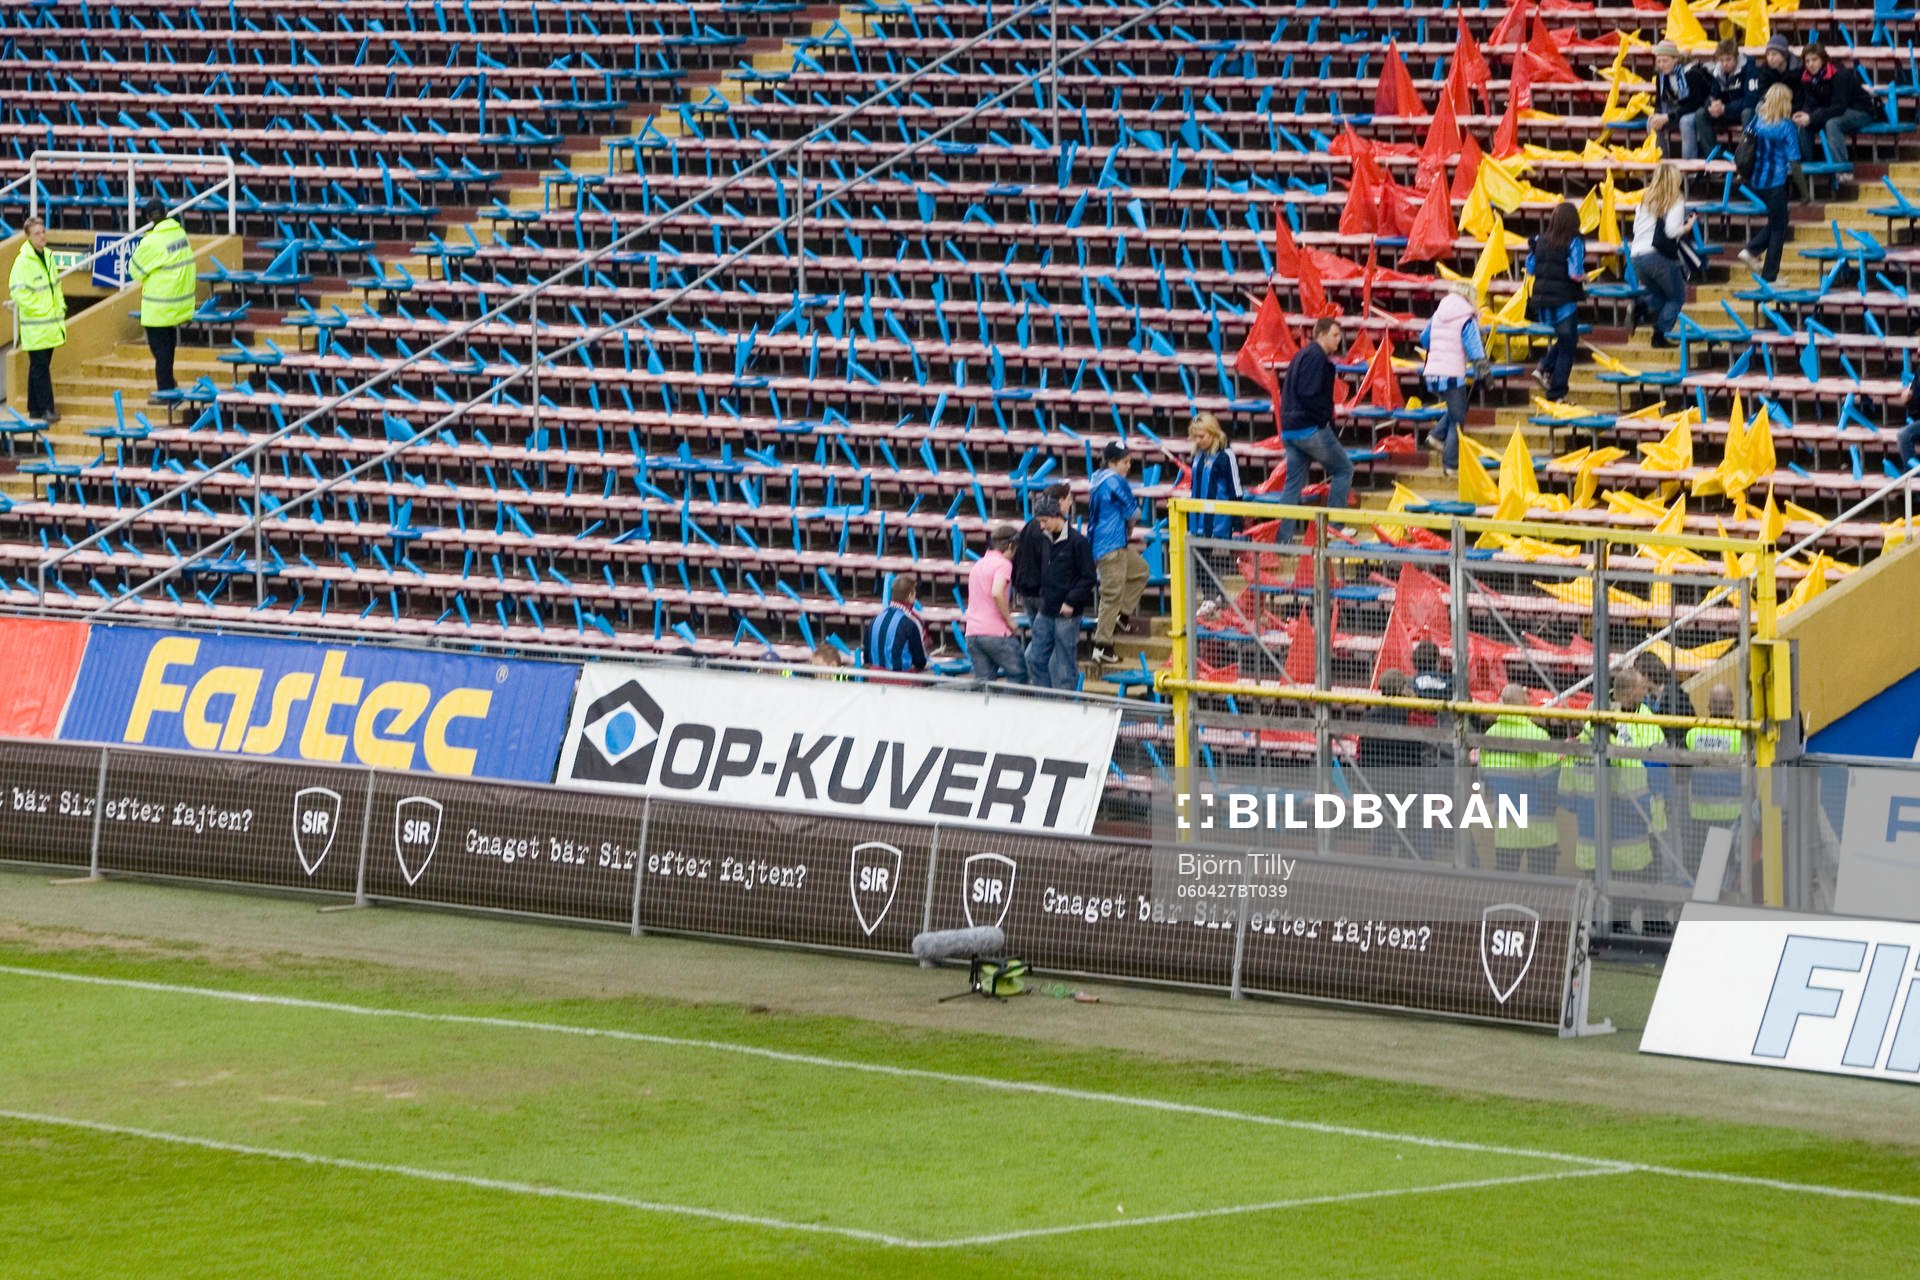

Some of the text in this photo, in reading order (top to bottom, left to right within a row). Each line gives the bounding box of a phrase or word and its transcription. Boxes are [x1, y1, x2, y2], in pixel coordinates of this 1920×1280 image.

[123, 637, 493, 776] Fastec
[659, 723, 1089, 828] OP-KUVERT
[13, 787, 50, 812] bär
[59, 790, 96, 816] Sir
[105, 797, 164, 823] efter
[171, 802, 253, 833] fajten?
[301, 810, 330, 835] SIR
[403, 819, 431, 845] SIR
[465, 828, 807, 890] Gnaget bär Sir efter fajten?
[859, 866, 889, 893] SIR
[972, 877, 1003, 904] SIR
[1042, 886, 1431, 952] Gnaget bär Sir efter fajten?
[1491, 929, 1525, 958] SIR
